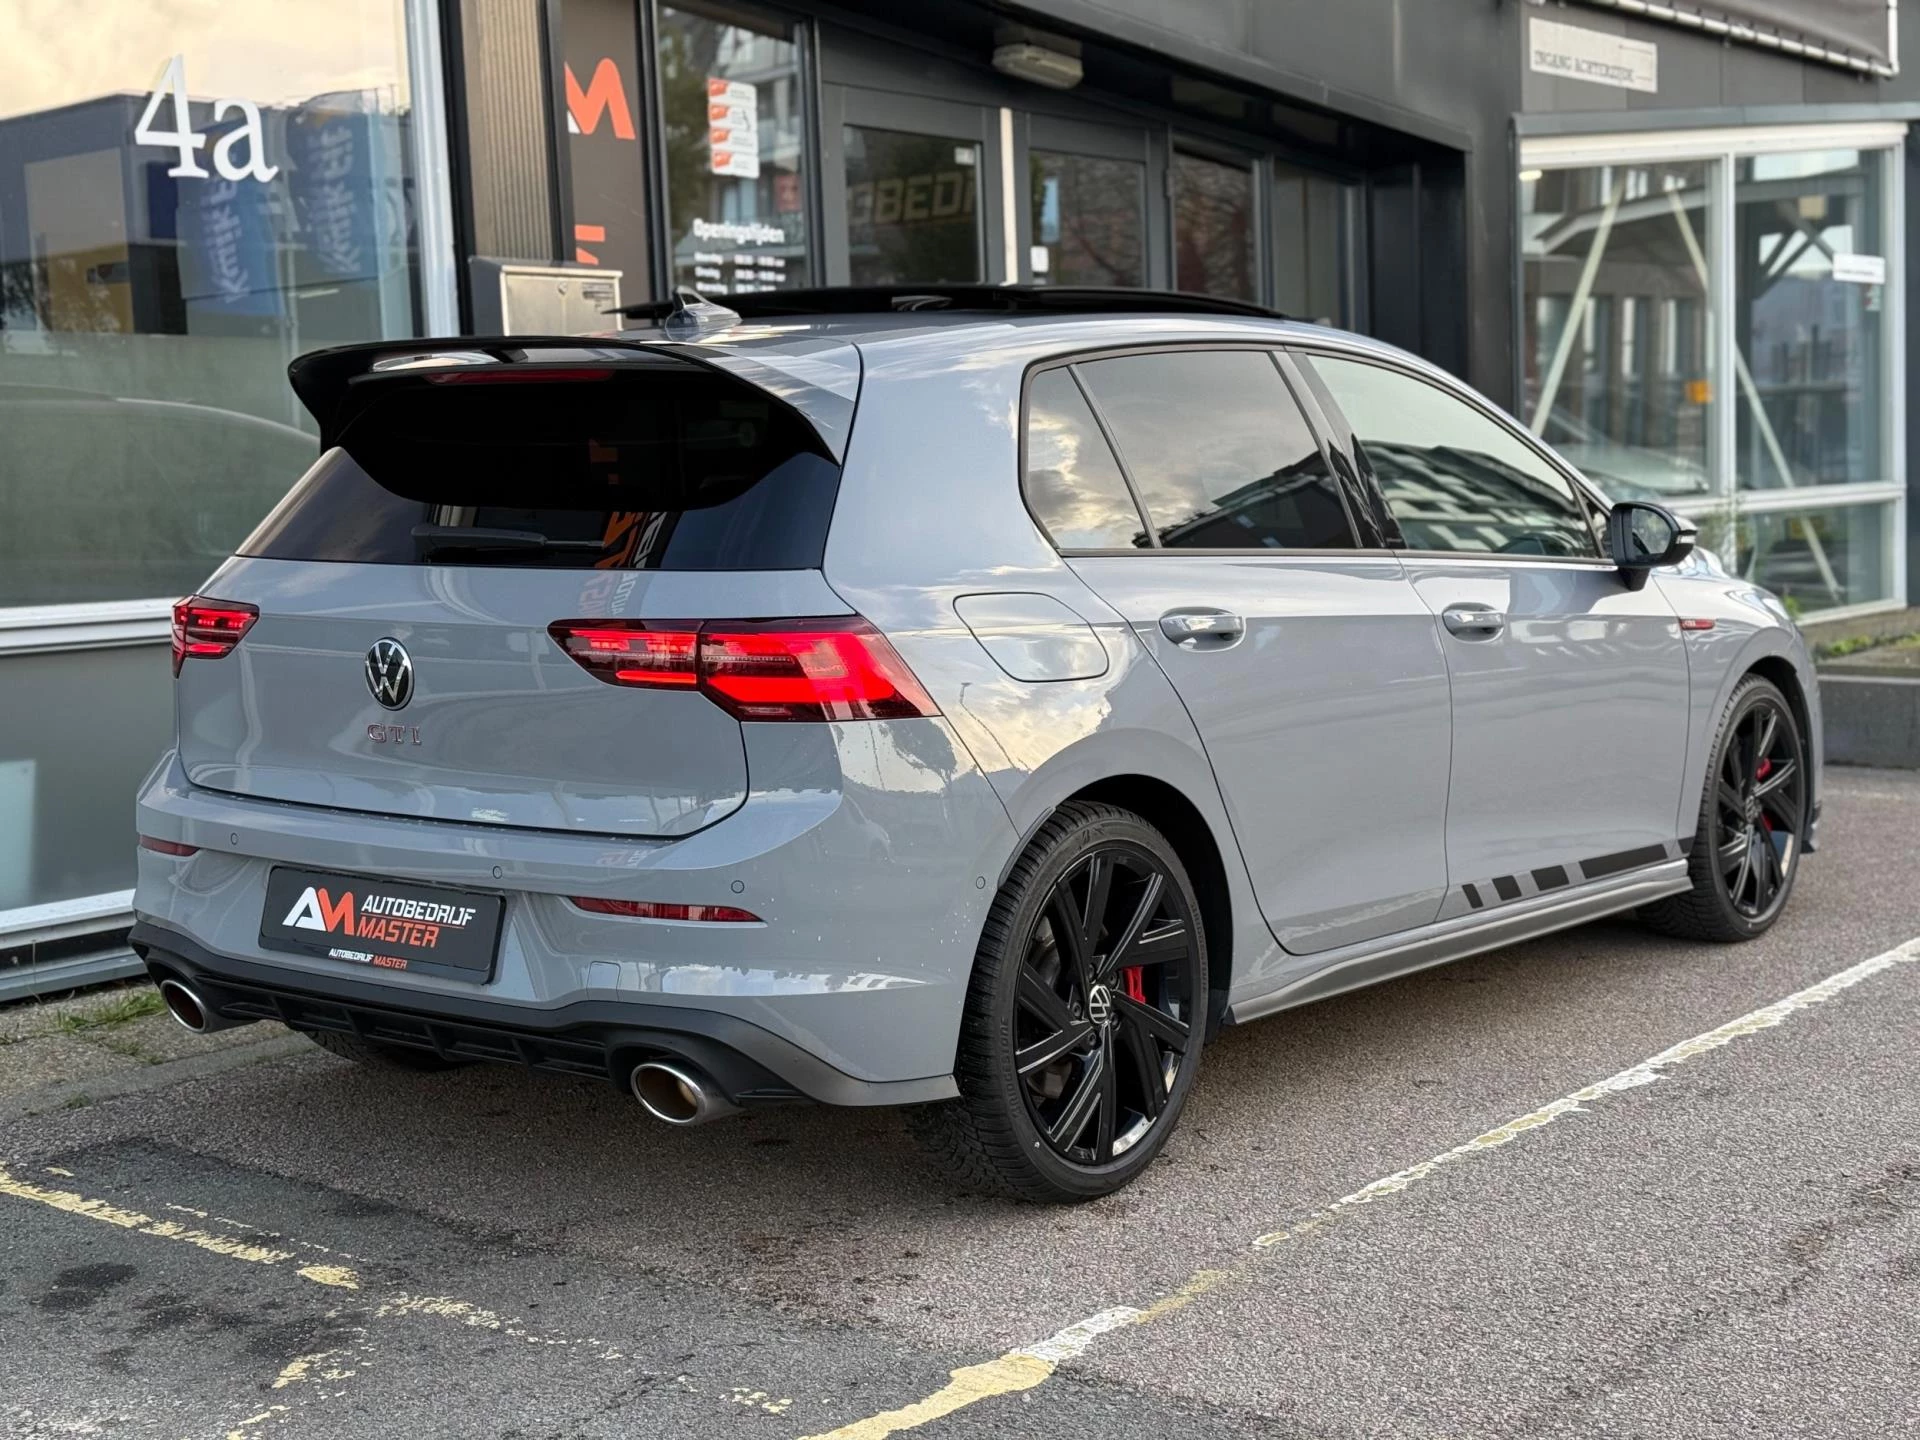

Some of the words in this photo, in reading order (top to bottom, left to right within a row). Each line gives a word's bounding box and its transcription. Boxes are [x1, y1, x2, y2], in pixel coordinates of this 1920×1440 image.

[134, 53, 279, 183] 4a
[367, 723, 422, 746] GTI
[282, 886, 354, 936] AM
[361, 895, 477, 926] AUTOBEDRIJF
[356, 916, 440, 948] MASTER
[328, 948, 374, 962] AUTOBEDRIJF
[373, 955, 408, 969] MASTER
